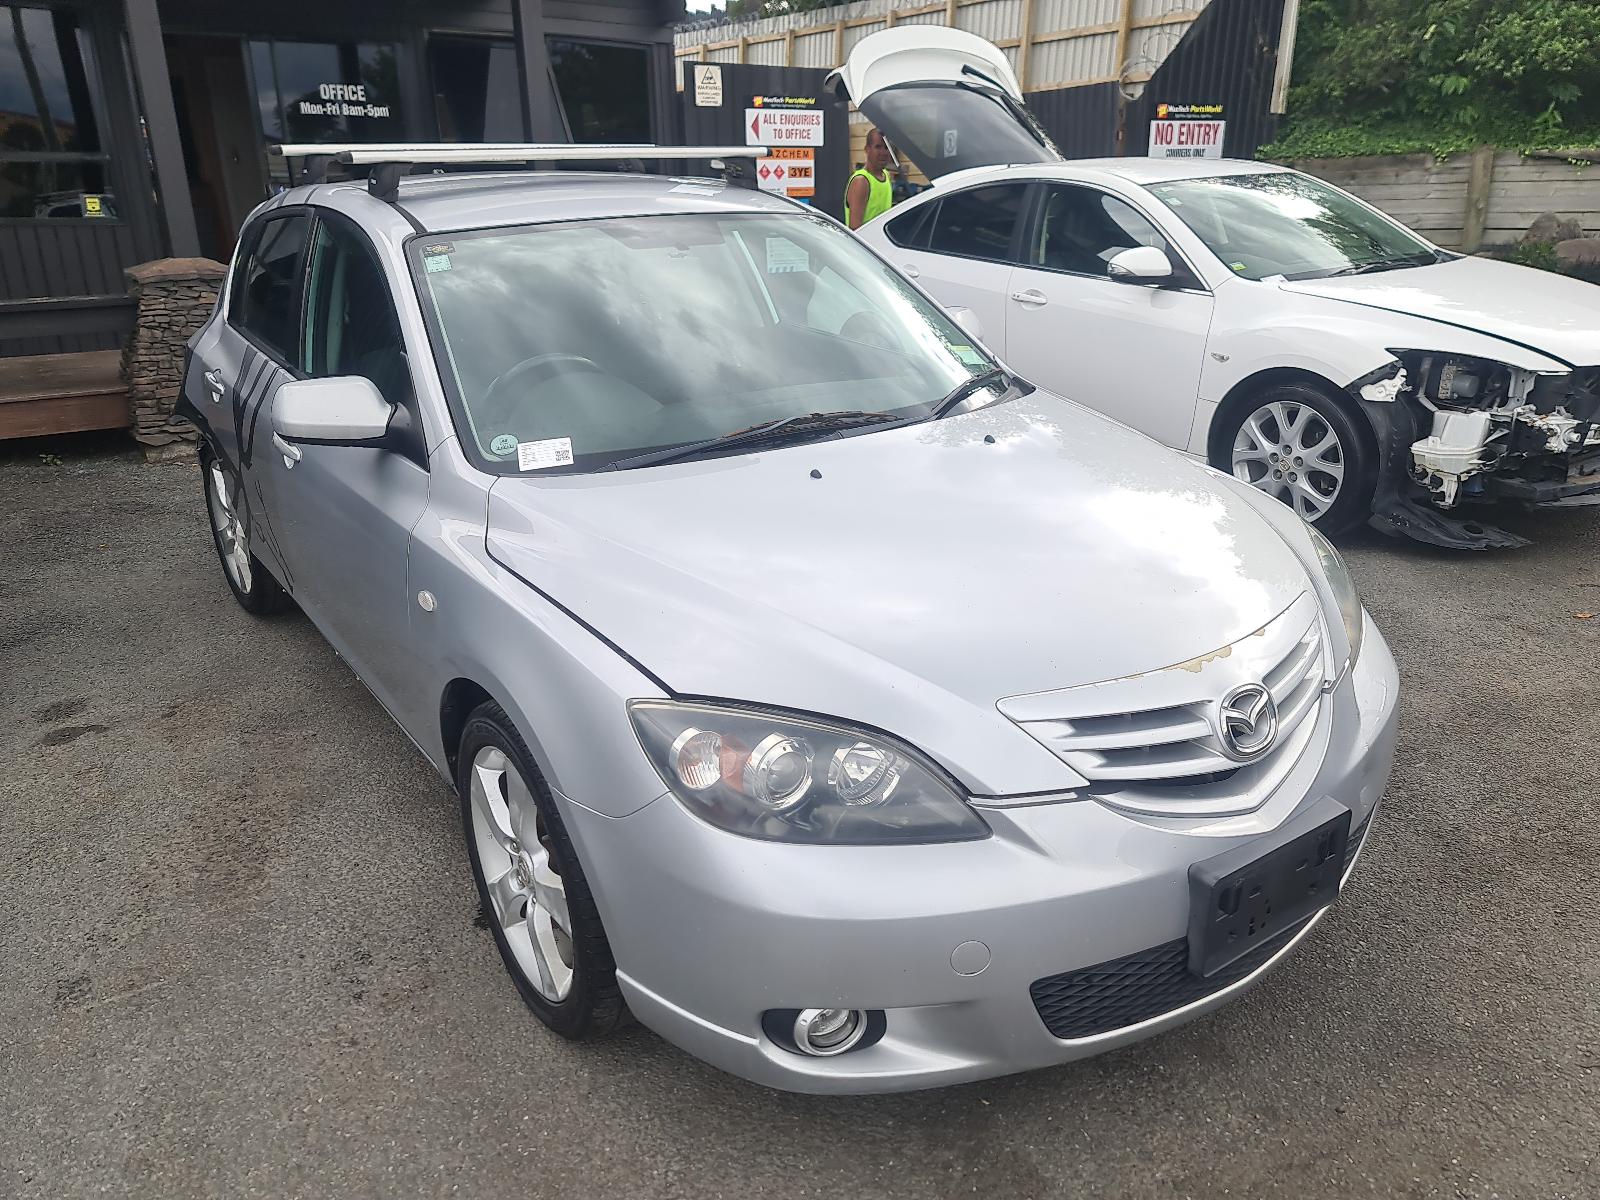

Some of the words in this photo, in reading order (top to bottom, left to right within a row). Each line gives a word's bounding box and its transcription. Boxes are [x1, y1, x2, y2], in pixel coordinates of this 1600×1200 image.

[319, 84, 366, 101] OFFICE
[299, 101, 340, 115] Mon-Fri
[341, 103, 390, 118] 8am-5pm
[763, 113, 777, 124] ALL
[780, 113, 821, 126] ENQUIRIES
[773, 128, 783, 140] TO
[785, 128, 812, 140] OFFICE
[1154, 123, 1174, 145] NO
[1177, 123, 1219, 145] ENTRY
[790, 167, 811, 177] 3YE
